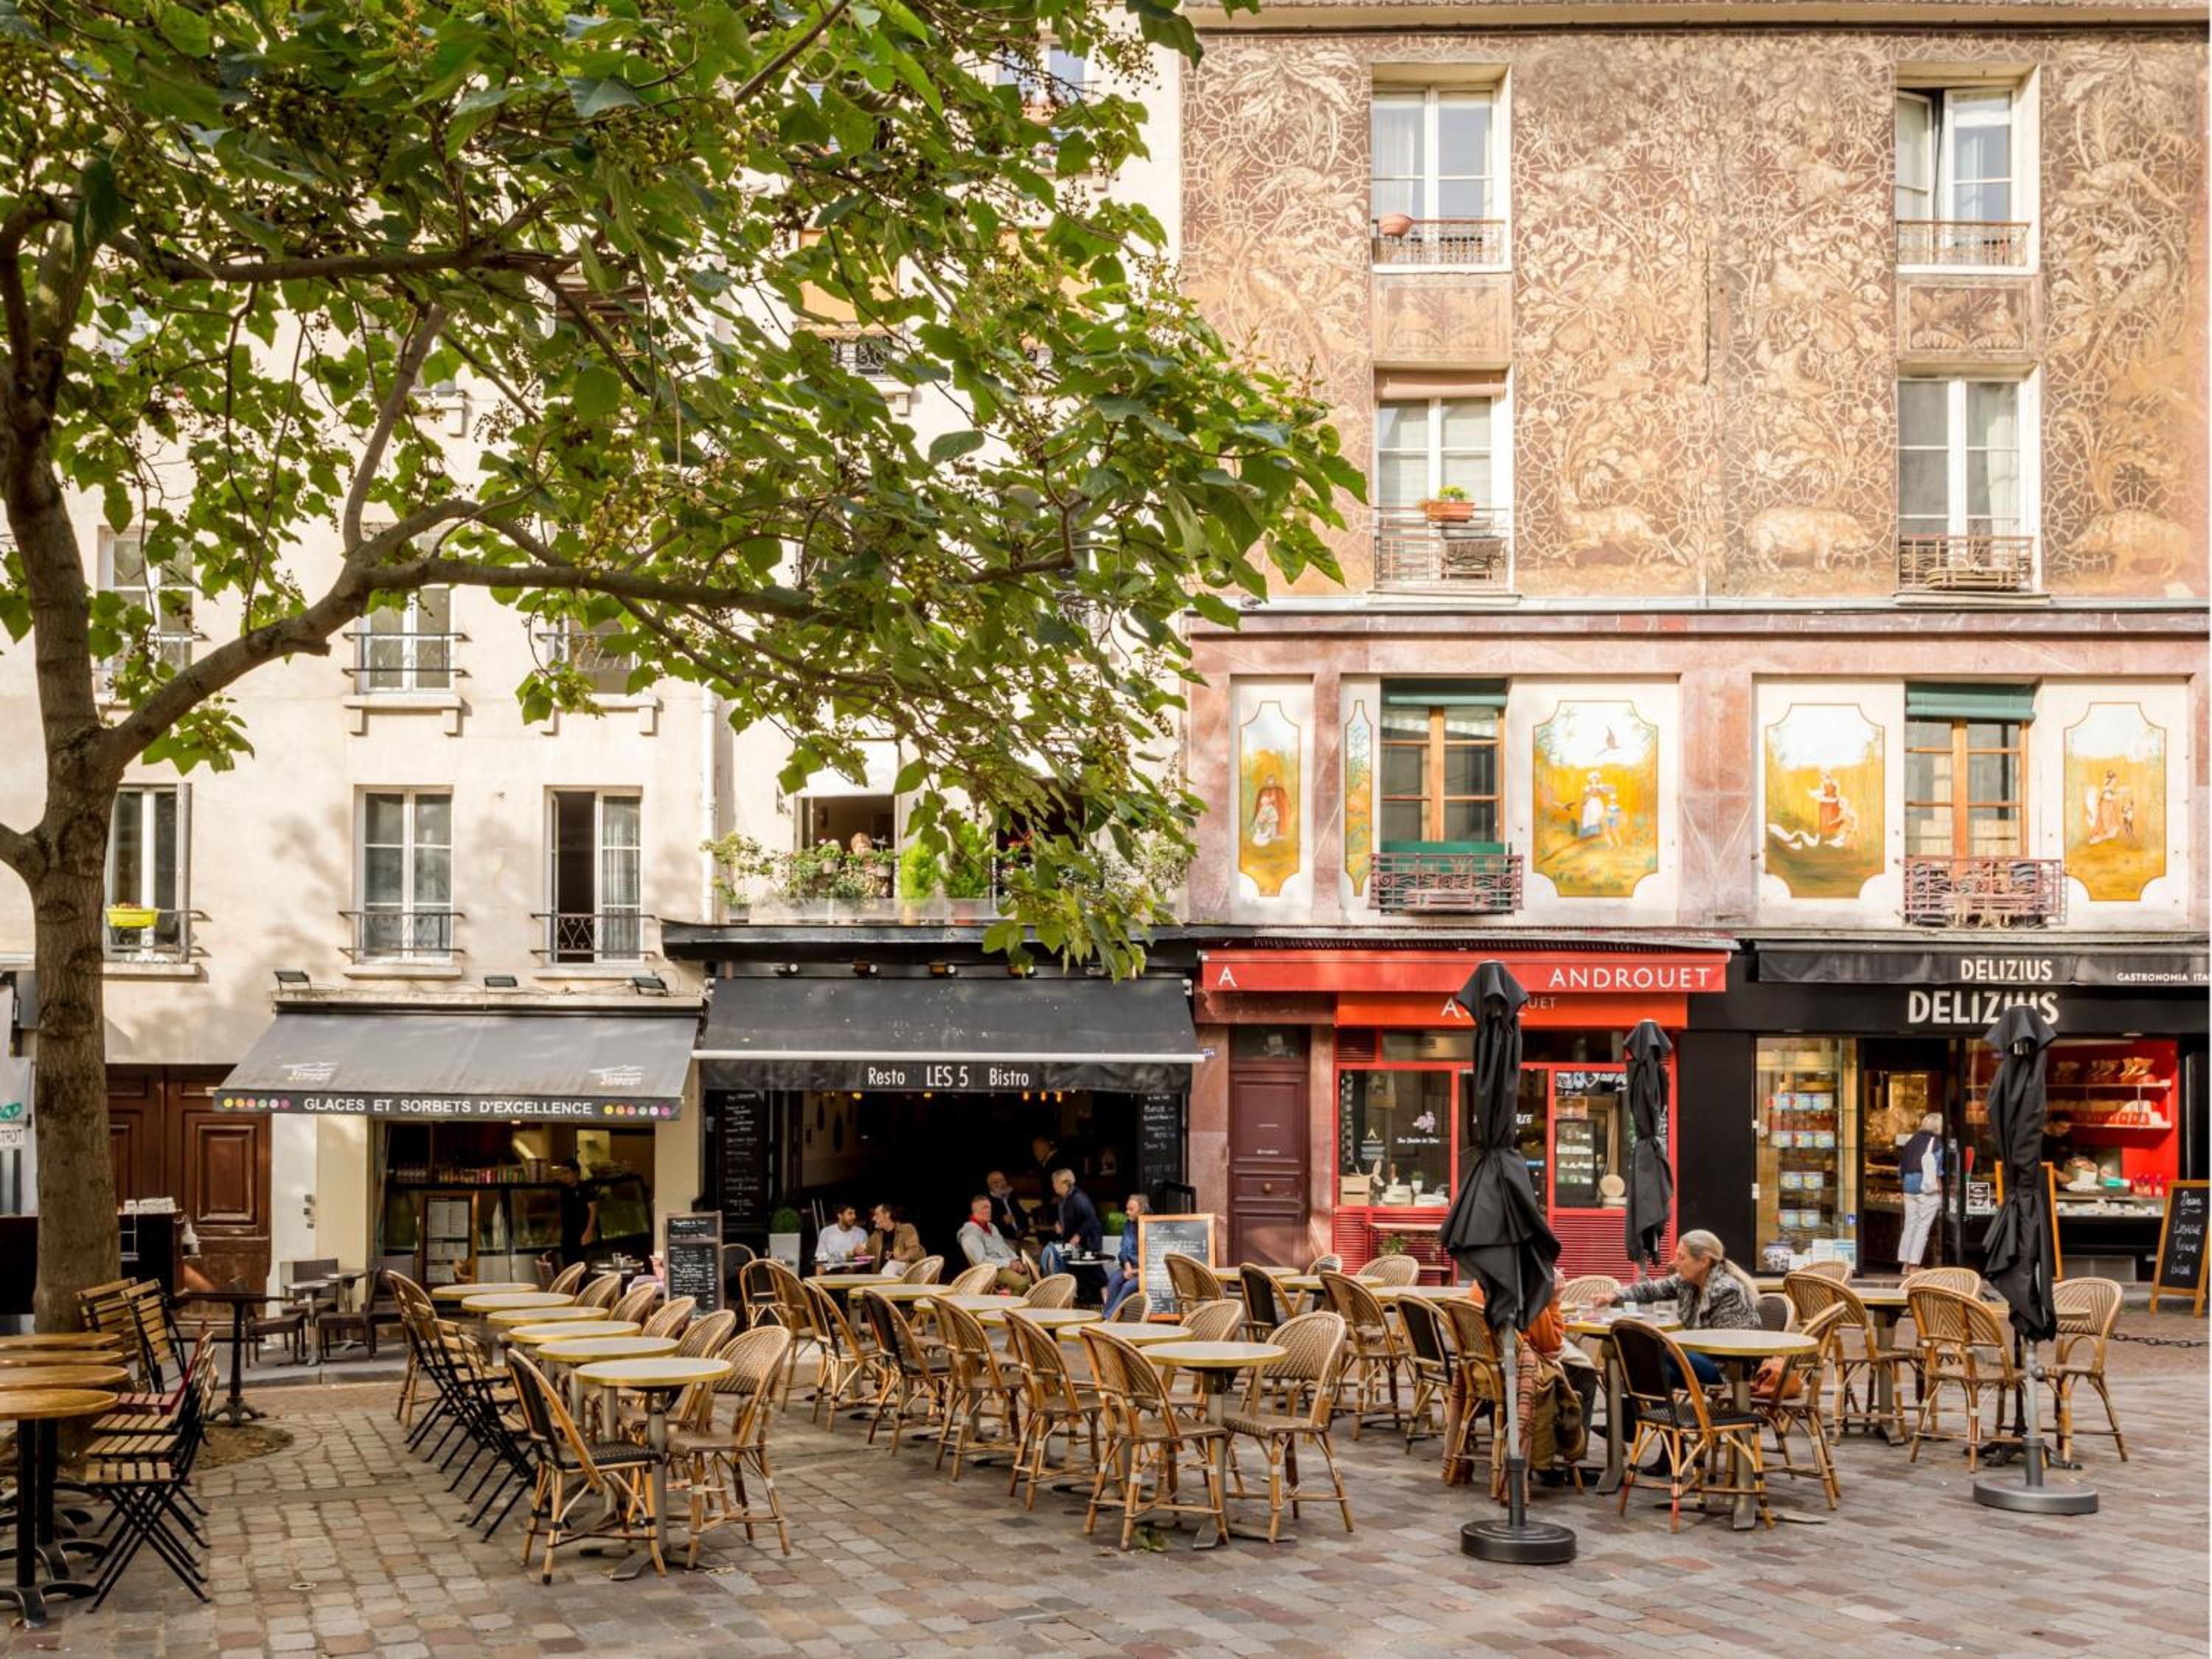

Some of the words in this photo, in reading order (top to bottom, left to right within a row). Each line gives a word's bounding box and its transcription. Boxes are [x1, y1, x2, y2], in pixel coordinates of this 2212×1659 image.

[1217, 964, 1239, 988] A
[1549, 967, 1711, 989] ANDROUET
[1960, 959, 2053, 981] DELIZIUS
[2117, 973, 2188, 981] GASTRONOMIA
[867, 1067, 905, 1085] Resto
[926, 1065, 953, 1087] LES
[959, 1065, 969, 1088] 5
[989, 1067, 1029, 1087] Bistro
[304, 1098, 366, 1111] GLACES
[373, 1099, 392, 1112] ET
[400, 1099, 471, 1113] SORBETS
[479, 1100, 592, 1115] D'EXCELLENCE
